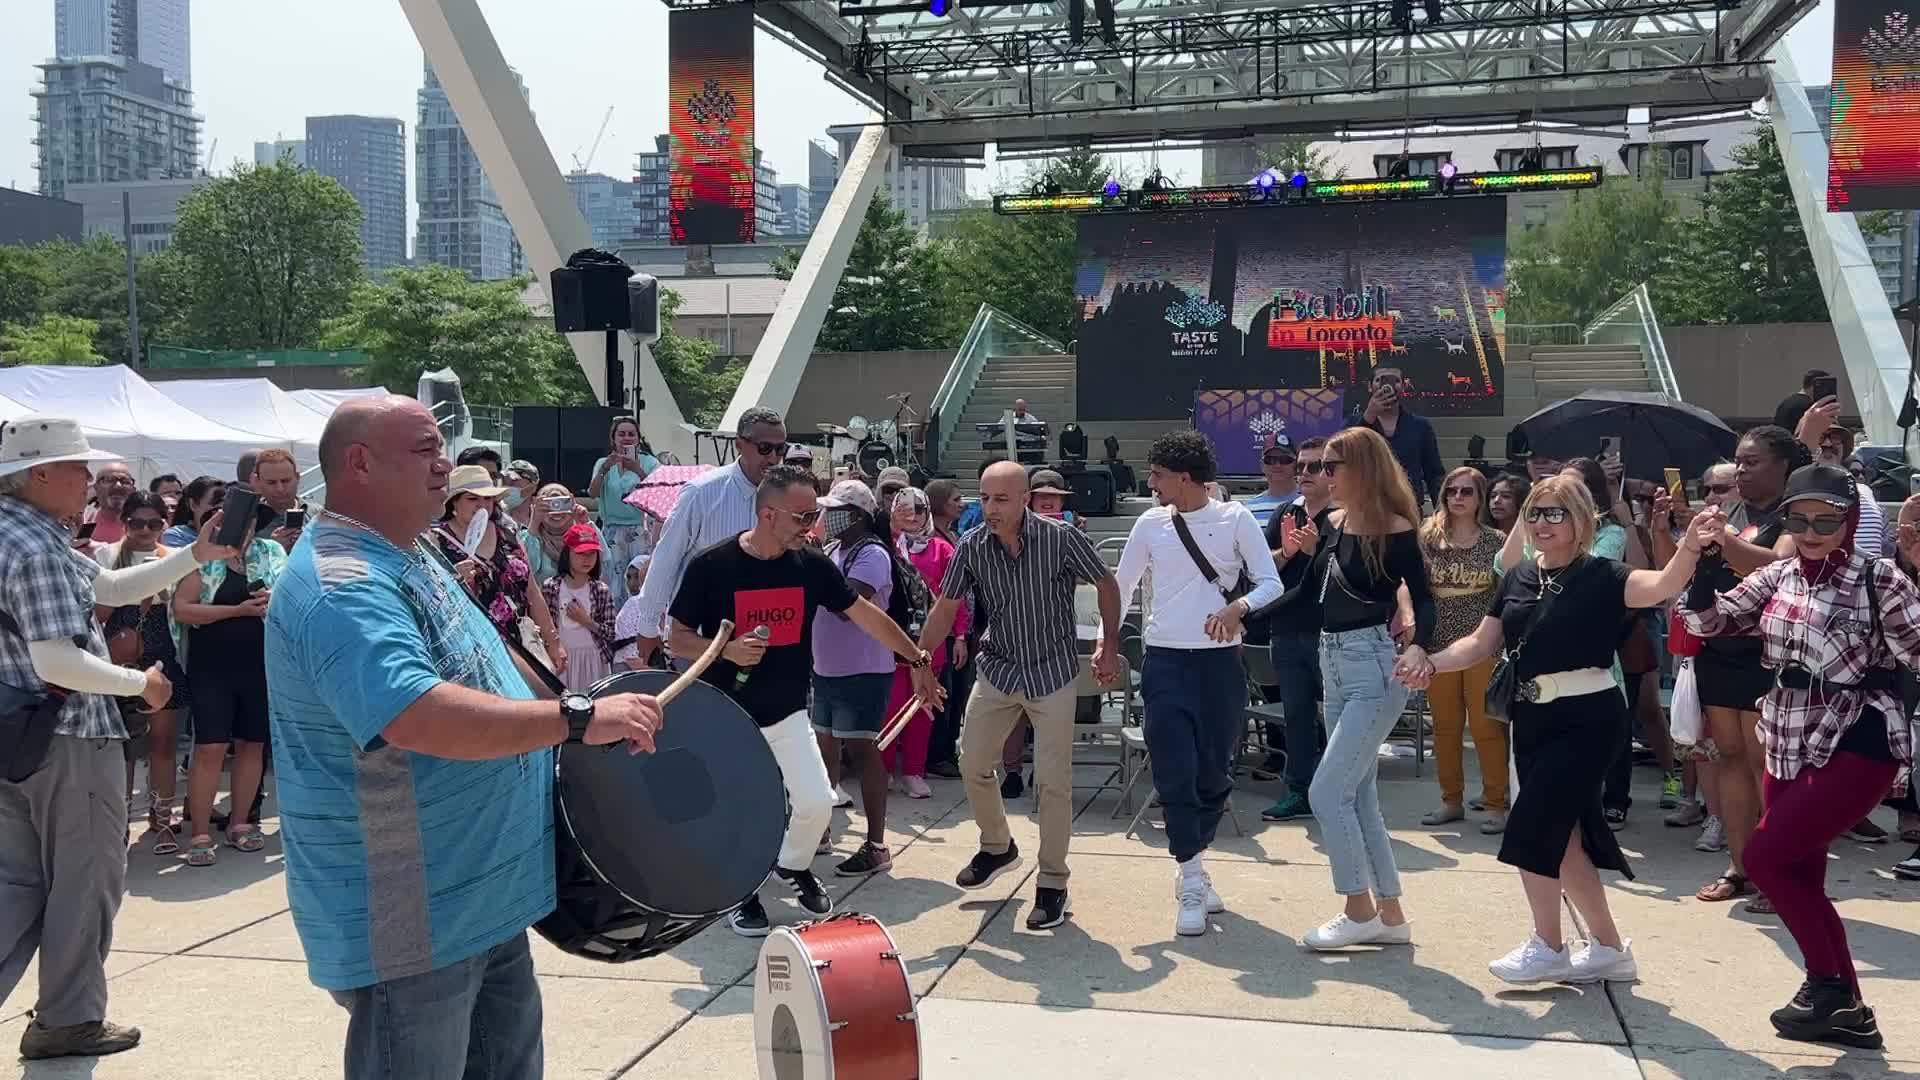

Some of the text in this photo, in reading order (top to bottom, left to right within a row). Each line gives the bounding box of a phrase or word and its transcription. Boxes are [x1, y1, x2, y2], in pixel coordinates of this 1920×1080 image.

[1172, 331, 1219, 343] TASTE
[1272, 323, 1387, 342] in Toronto
[746, 607, 795, 624] HUGO
